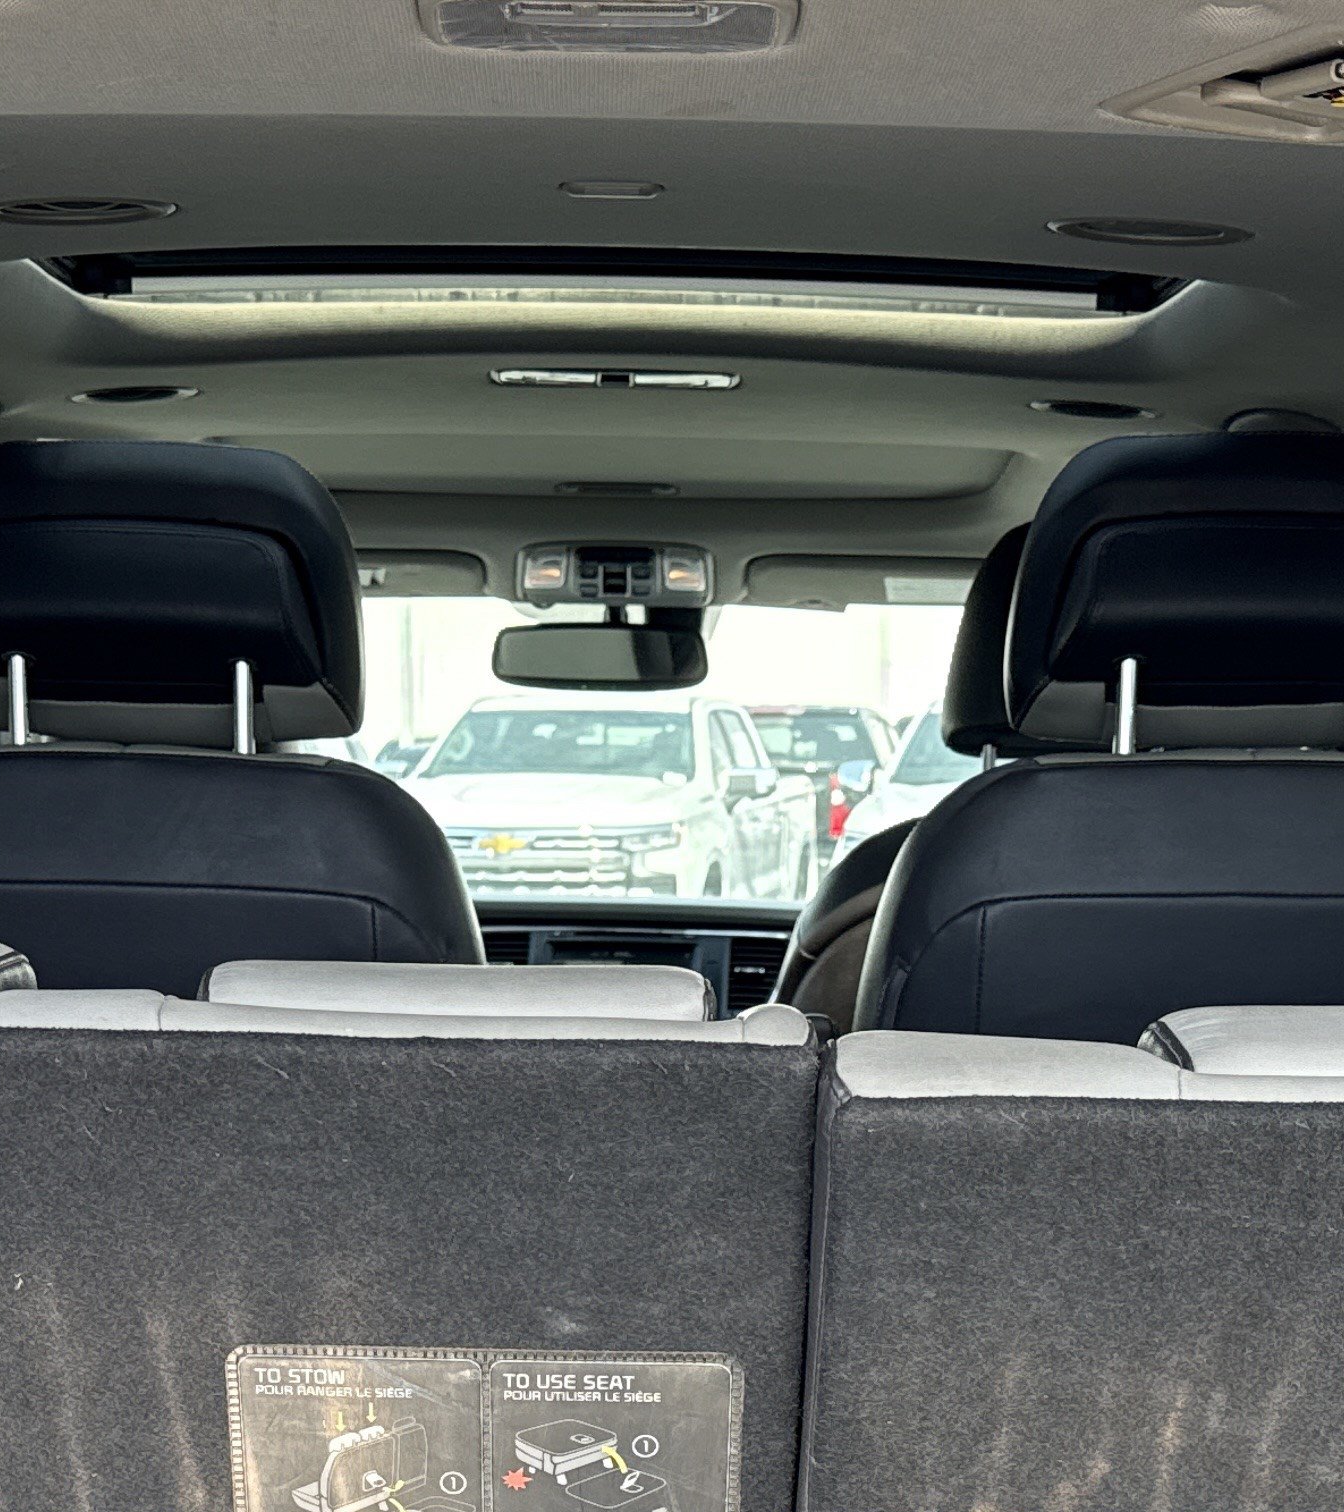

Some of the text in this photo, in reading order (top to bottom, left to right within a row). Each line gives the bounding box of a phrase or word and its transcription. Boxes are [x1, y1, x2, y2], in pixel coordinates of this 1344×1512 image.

[253, 1367, 345, 1385] TO STOW
[503, 1373, 635, 1390] TO USE SEAT
[256, 1384, 293, 1395] POUR
[297, 1386, 353, 1397] RANGER
[355, 1386, 372, 1398] LE
[503, 1390, 541, 1401] POUR
[545, 1391, 602, 1402] UTILISER
[605, 1392, 620, 1402] LE
